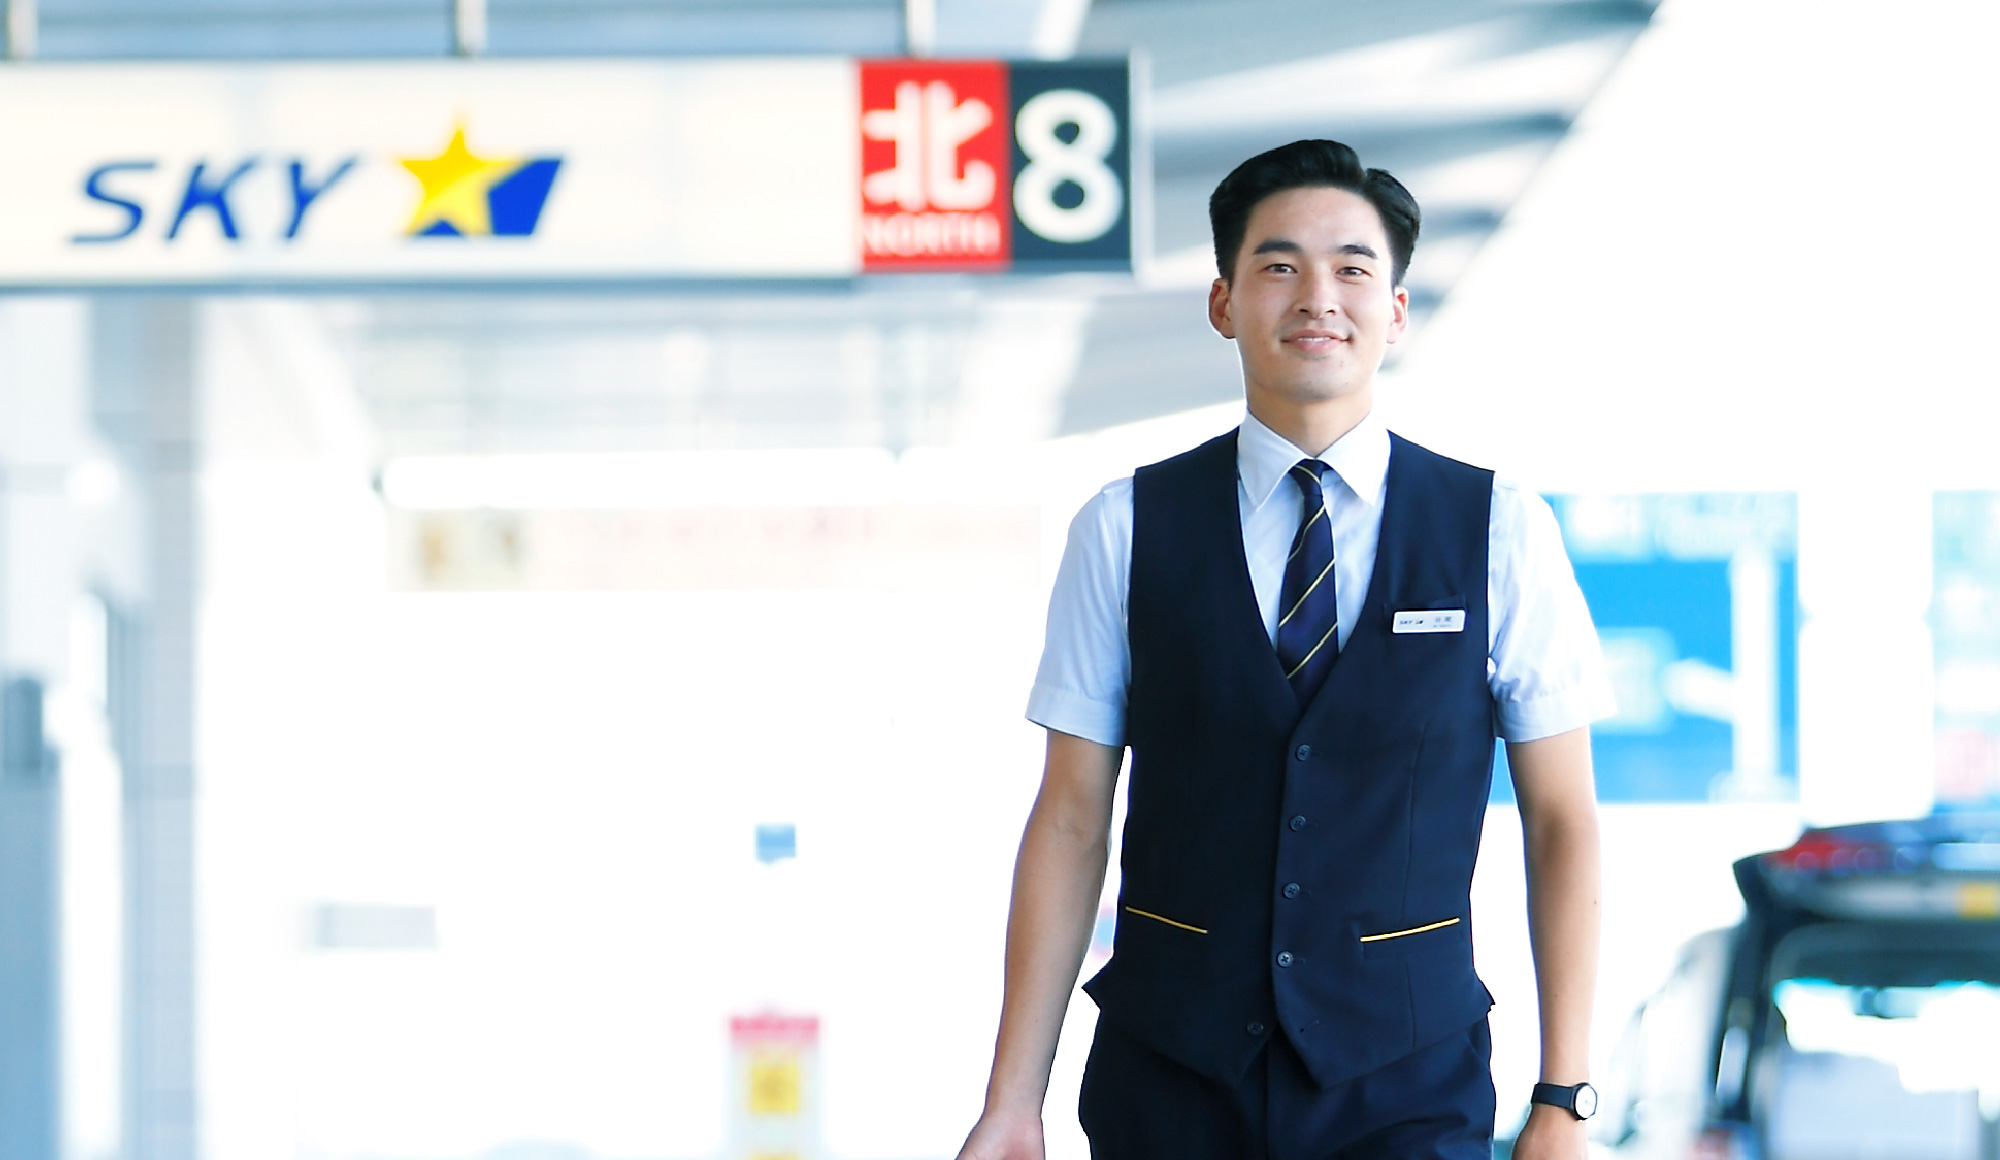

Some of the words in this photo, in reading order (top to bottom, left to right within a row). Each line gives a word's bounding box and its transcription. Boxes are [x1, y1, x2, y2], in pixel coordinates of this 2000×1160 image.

[70, 158, 356, 242] SKY
[863, 80, 996, 212] 北
[1013, 88, 1123, 243] 8
[863, 212, 1000, 256] NORTH
